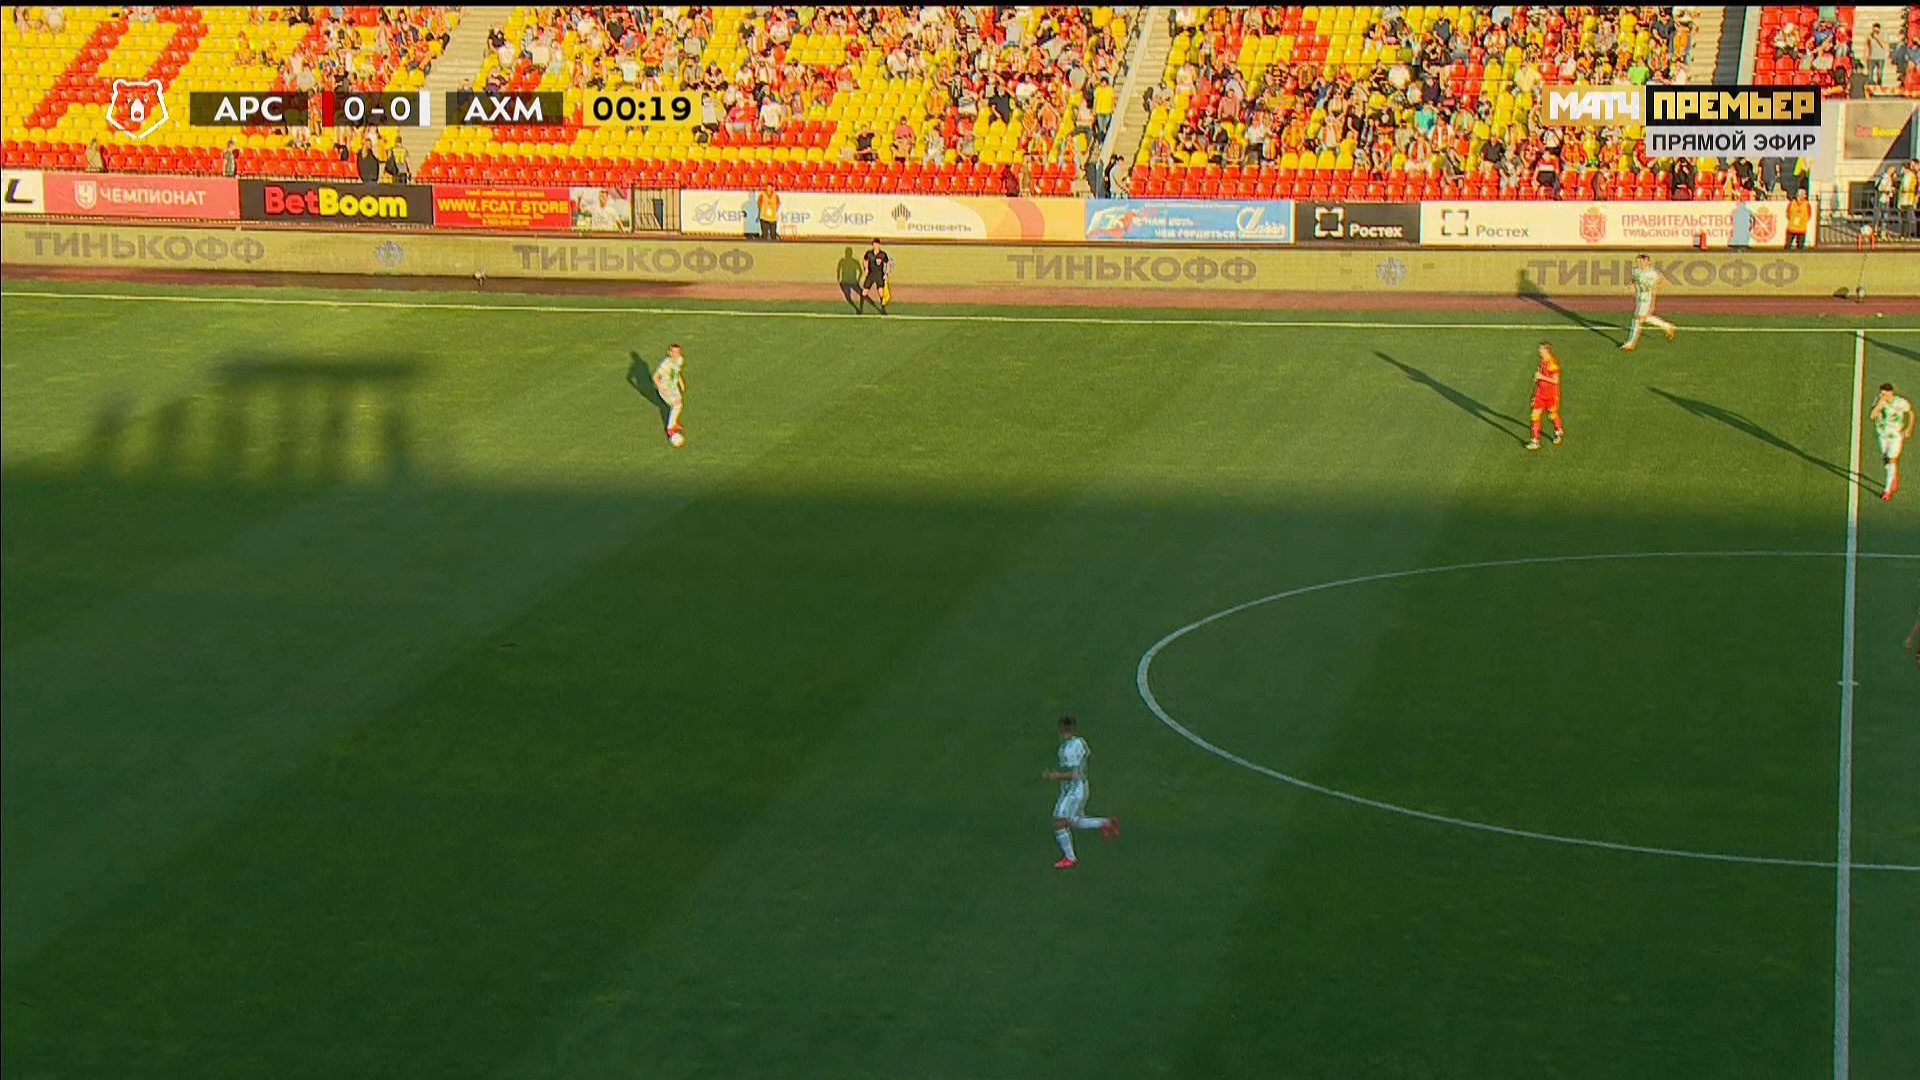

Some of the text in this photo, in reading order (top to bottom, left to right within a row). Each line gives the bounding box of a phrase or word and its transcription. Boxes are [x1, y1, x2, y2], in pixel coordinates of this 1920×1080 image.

[100, 187, 207, 206] ЧЕМПИОНАТ
[264, 186, 408, 218] BetBoom
[437, 198, 569, 215] WWW.FCAT.STORE
[907, 222, 972, 233] РОСНЕФТЬ
[1621, 214, 1734, 228] ПРАВИТЕЛЬСТВО
[1349, 222, 1403, 239] Ростех
[1476, 224, 1530, 239] Ростех
[25, 231, 265, 263] ТИНЬКОФФ
[512, 244, 754, 276] ТИНЬКОФФ
[1006, 254, 1257, 284] ТИНЬКОФФ
